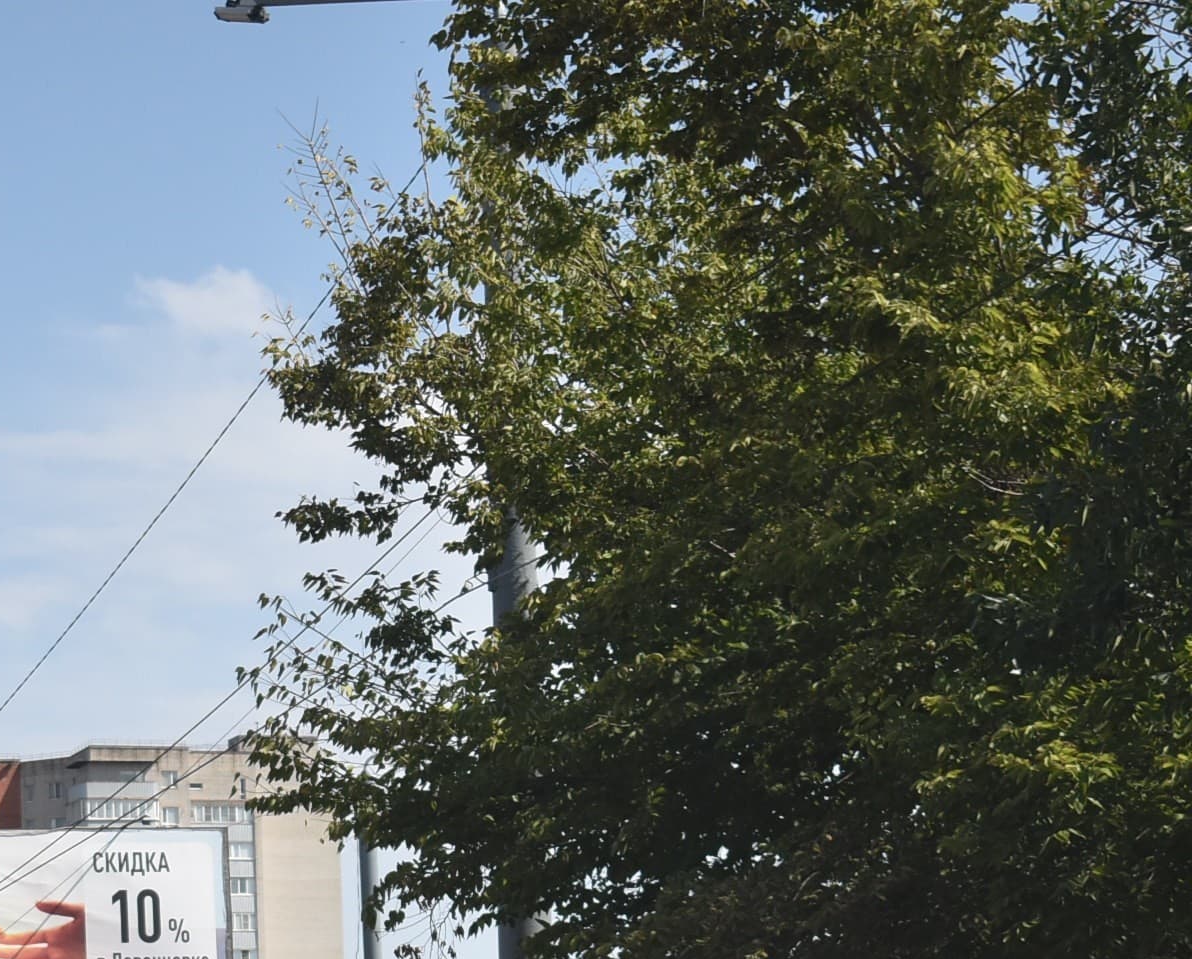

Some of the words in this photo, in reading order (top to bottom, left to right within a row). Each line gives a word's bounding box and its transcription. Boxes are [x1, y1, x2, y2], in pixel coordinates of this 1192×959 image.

[92, 851, 170, 876] СКИДКА
[111, 888, 162, 944] 10
[168, 917, 190, 943] %
